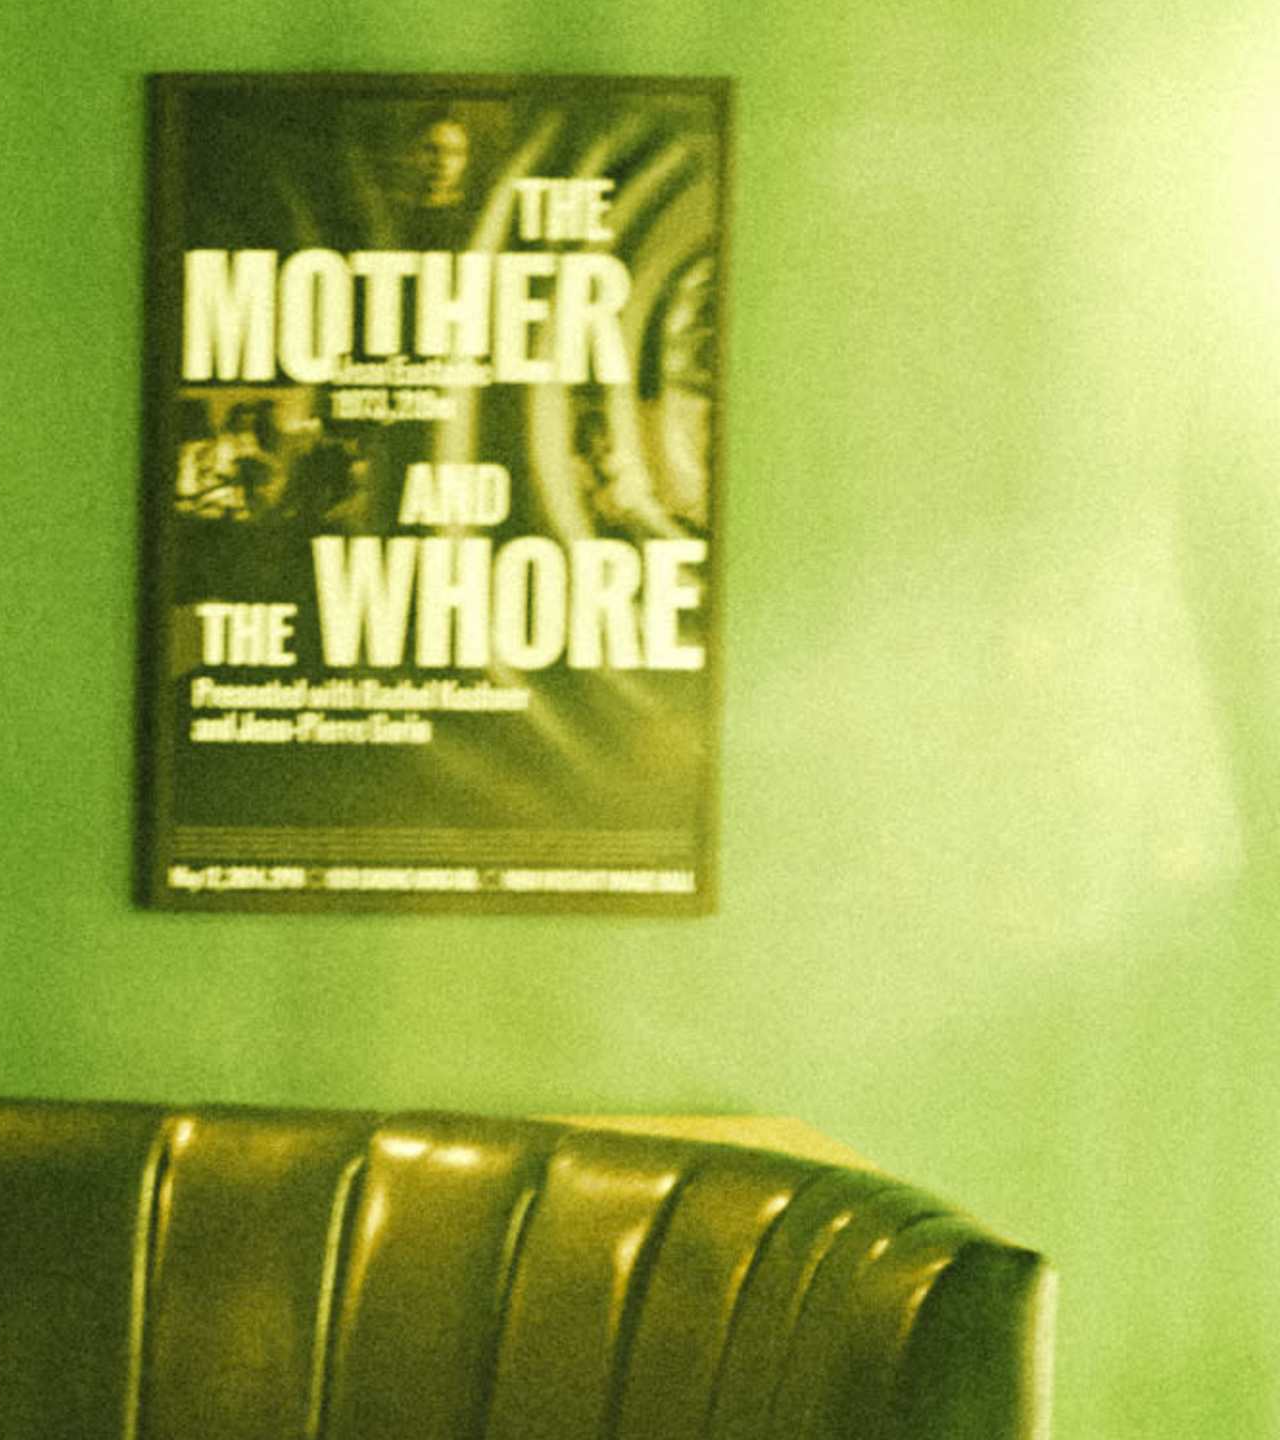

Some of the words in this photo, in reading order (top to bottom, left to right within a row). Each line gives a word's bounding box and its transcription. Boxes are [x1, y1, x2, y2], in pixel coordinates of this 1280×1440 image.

[514, 176, 616, 243] THE
[181, 247, 633, 386] MOTHER
[399, 462, 511, 527] AND
[194, 602, 298, 666] THE
[311, 536, 708, 671] WHORE
